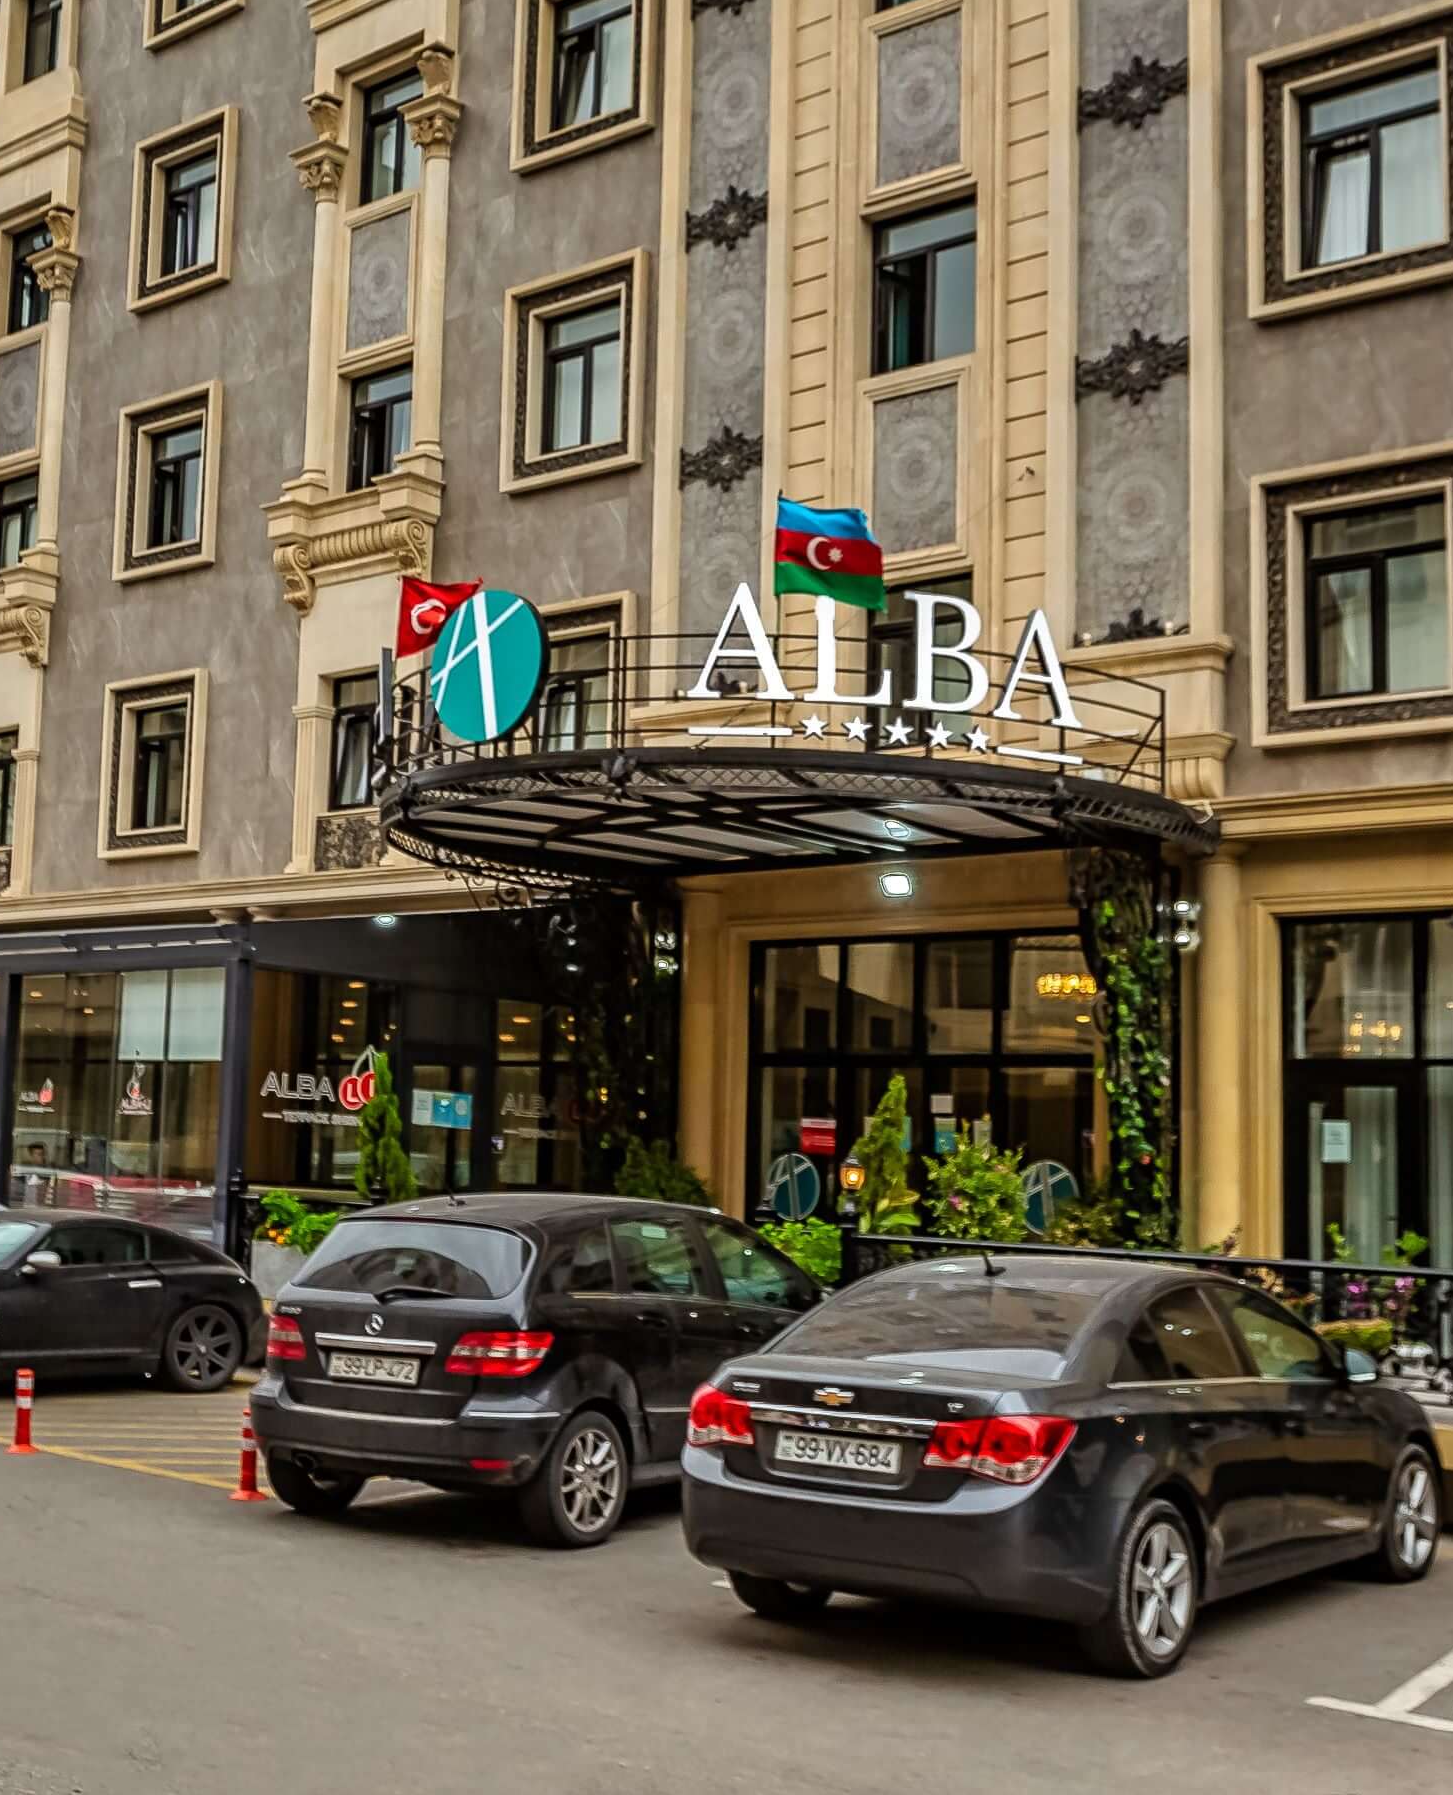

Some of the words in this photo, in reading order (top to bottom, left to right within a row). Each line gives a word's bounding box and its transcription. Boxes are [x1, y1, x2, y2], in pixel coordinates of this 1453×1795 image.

[686, 582, 1083, 728] ALBA
[260, 1071, 336, 1102] ALBA
[794, 1435, 895, 1468] 99-VX-684
